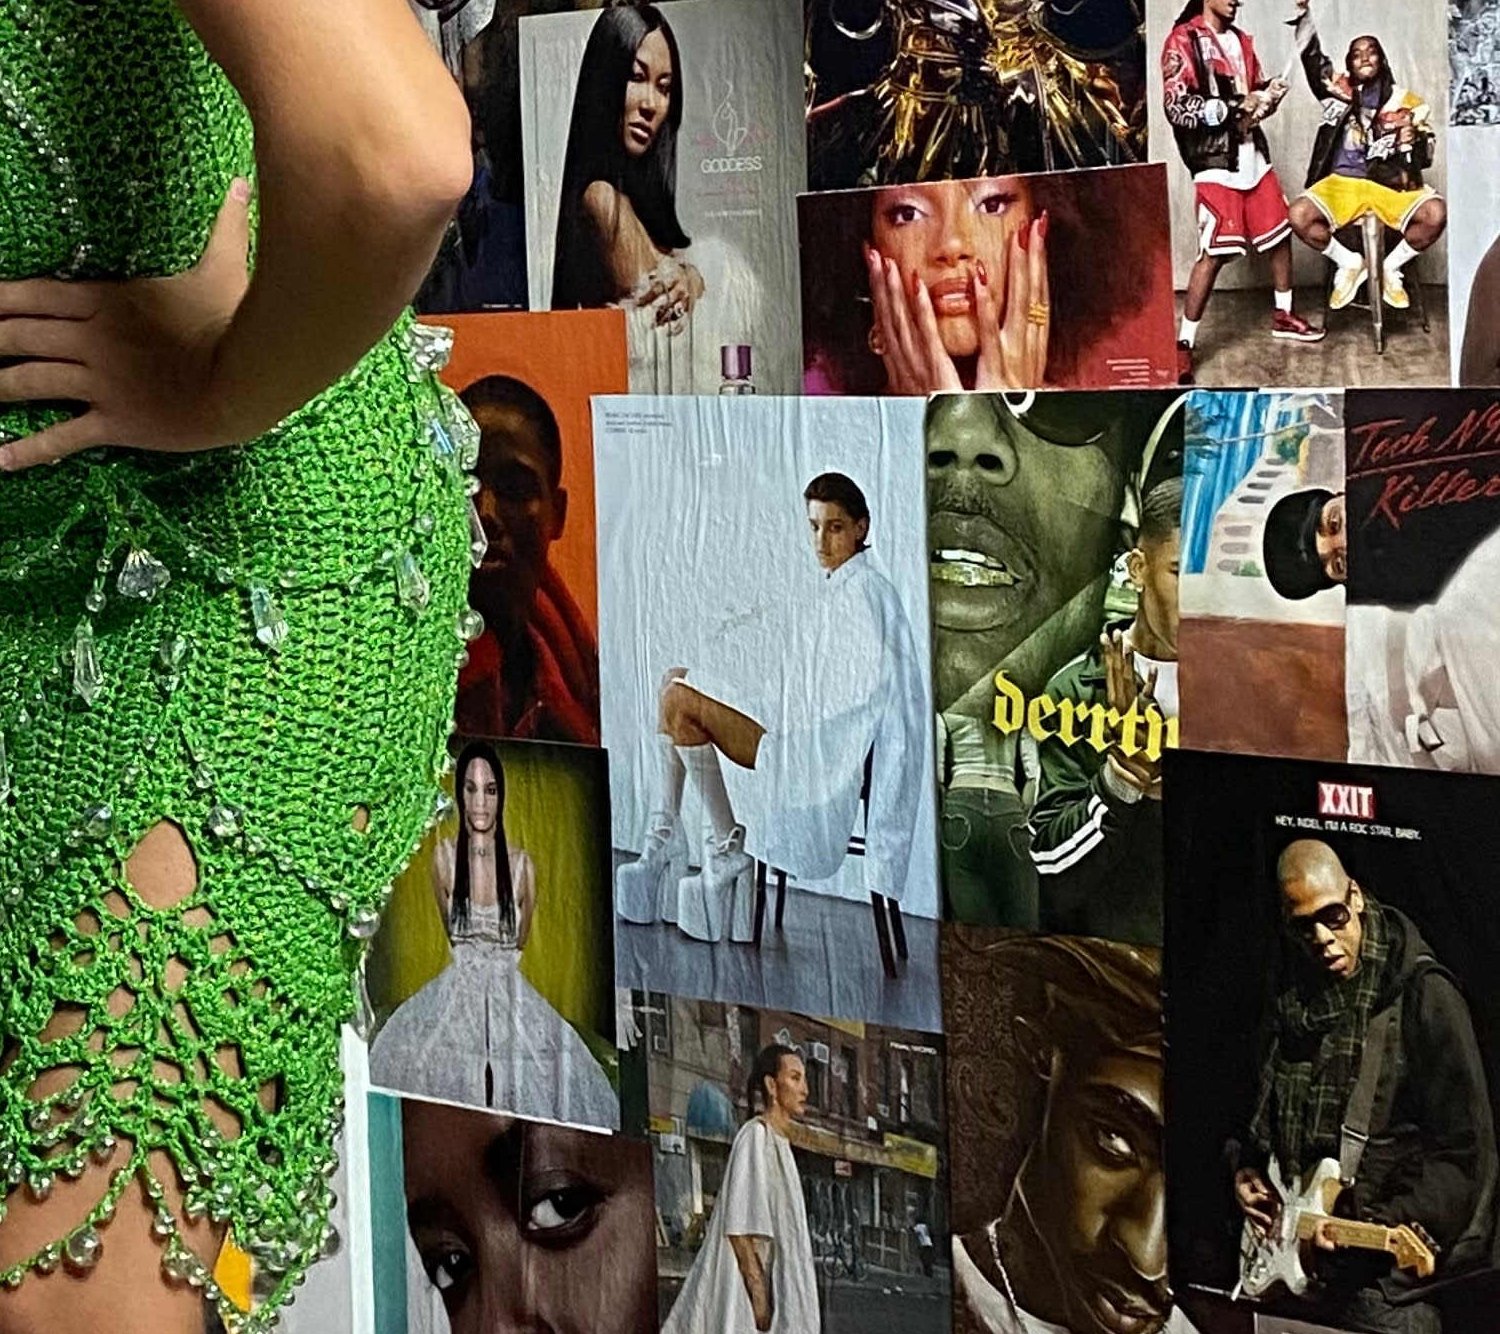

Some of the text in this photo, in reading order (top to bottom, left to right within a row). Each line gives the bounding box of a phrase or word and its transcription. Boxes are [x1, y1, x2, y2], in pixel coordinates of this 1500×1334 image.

[700, 155, 763, 174] GODDESS
[1351, 416, 1438, 468] Tech
[1340, 821, 1348, 833] A
